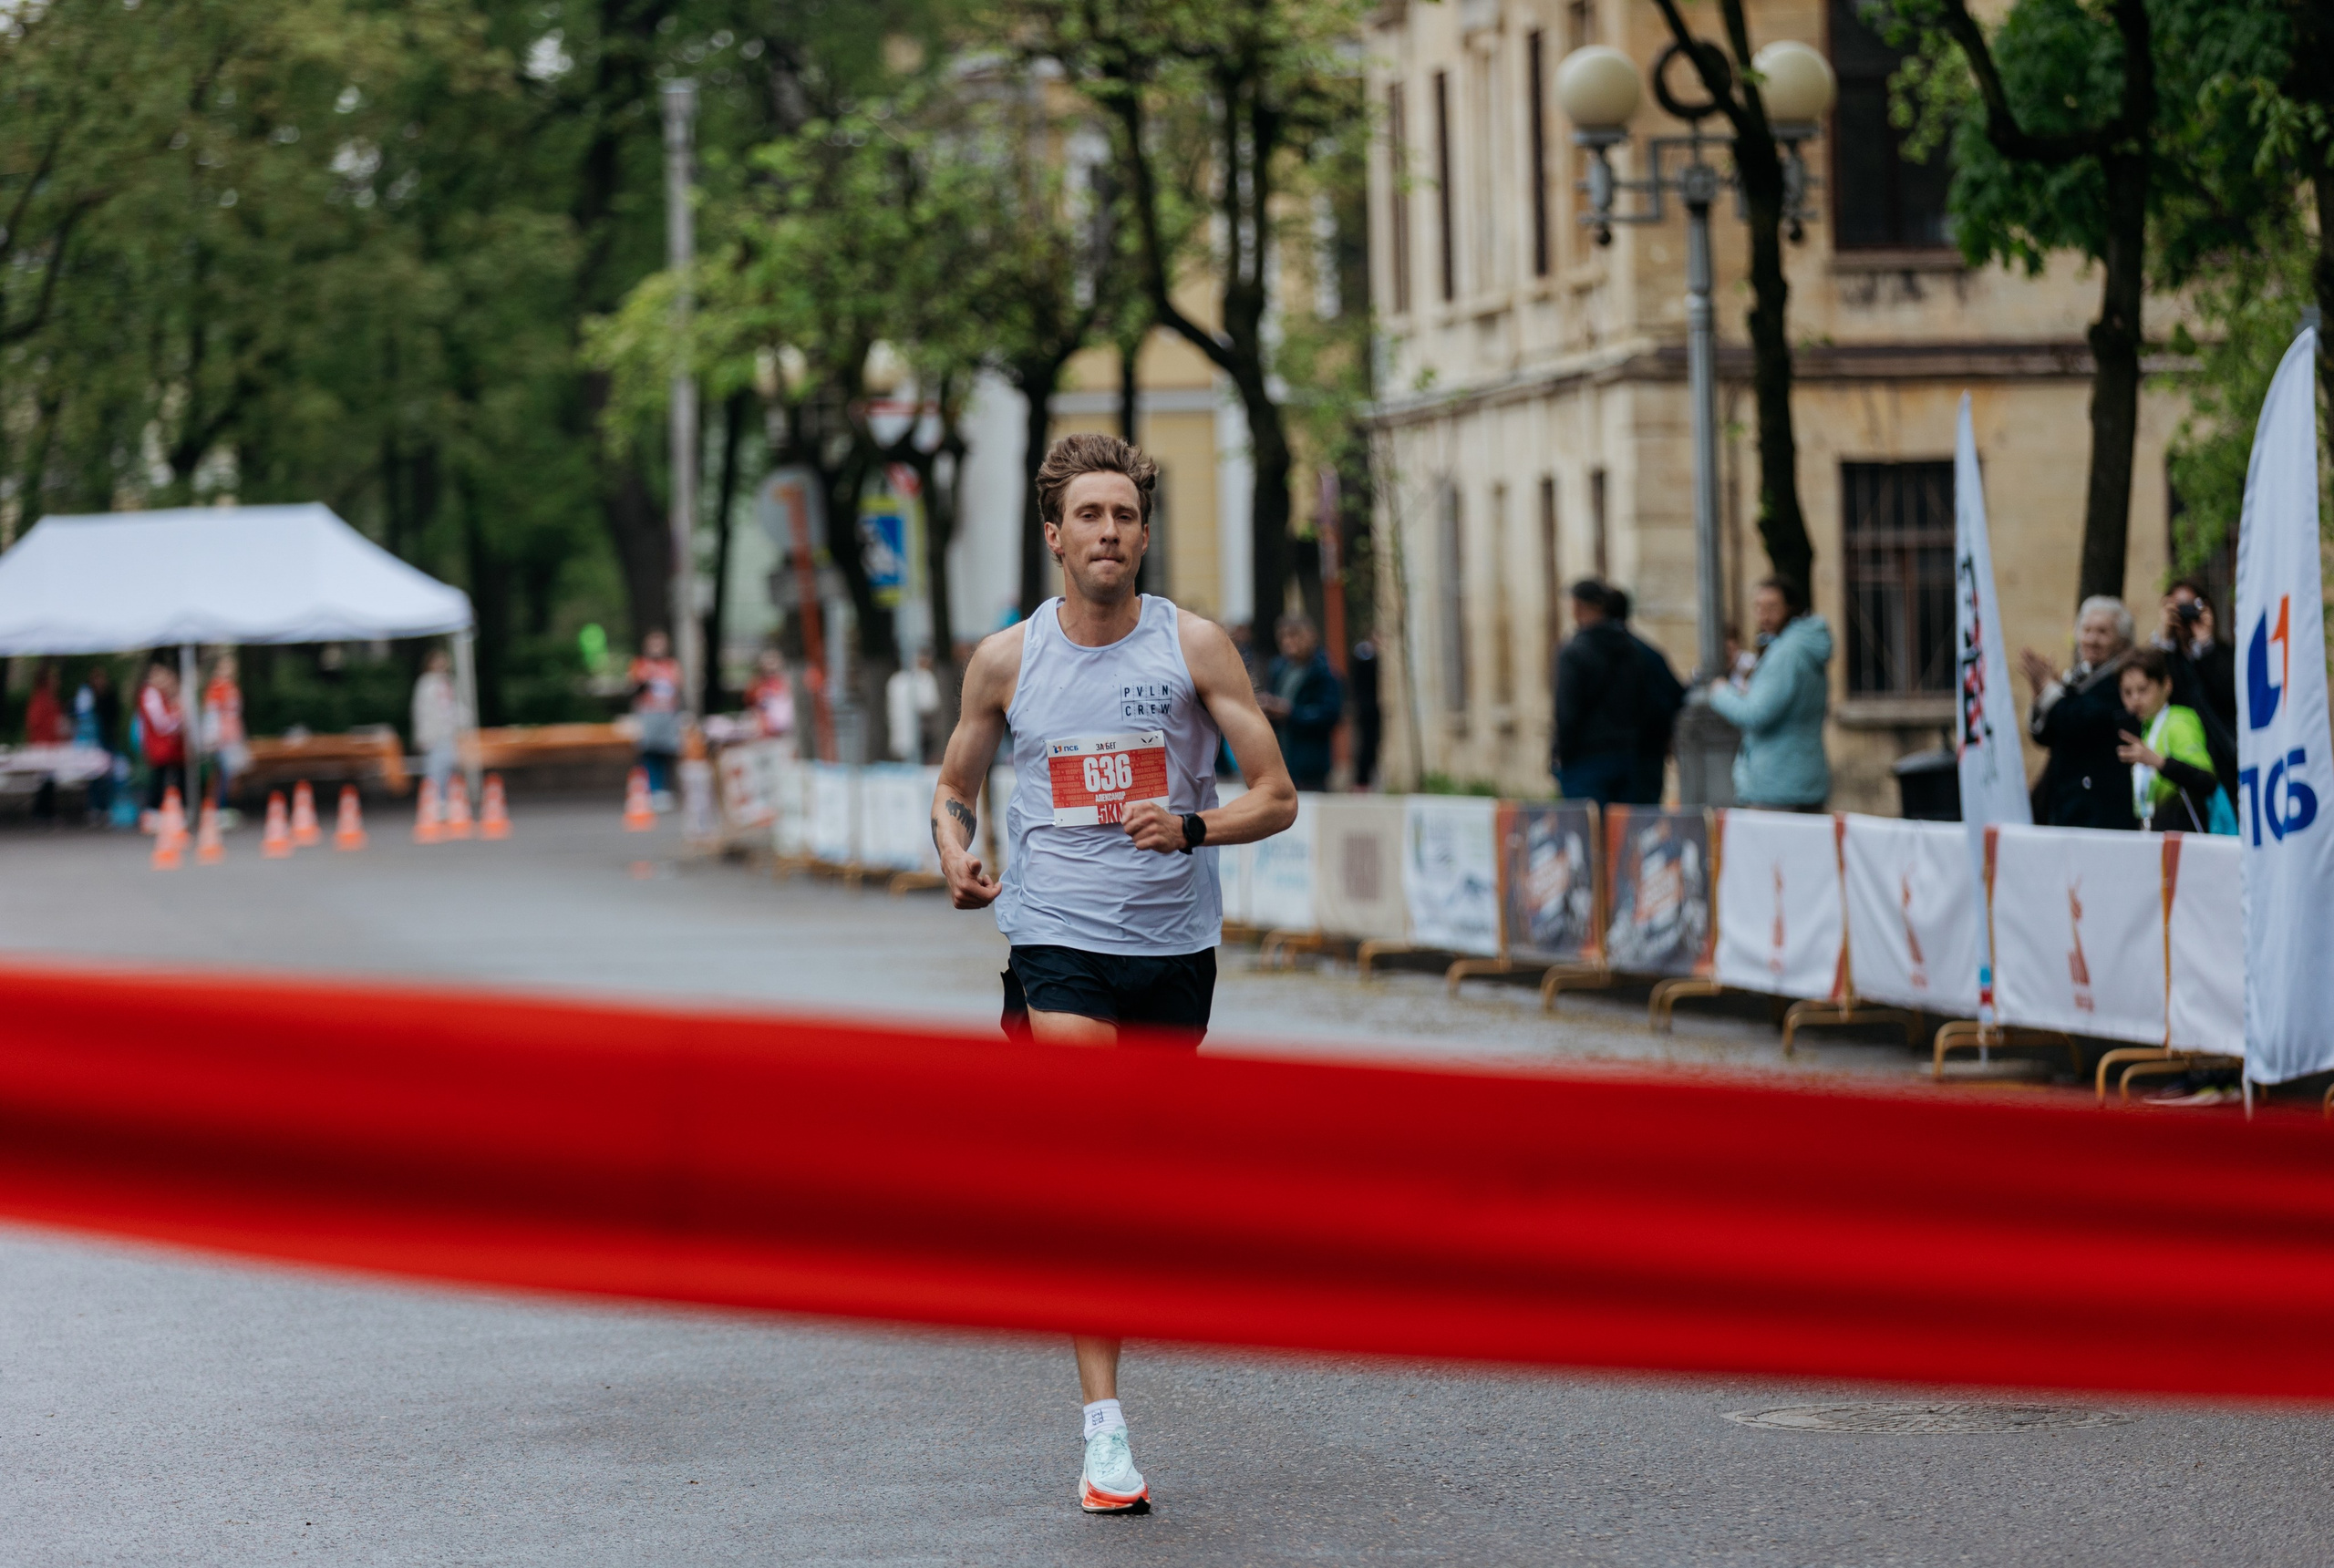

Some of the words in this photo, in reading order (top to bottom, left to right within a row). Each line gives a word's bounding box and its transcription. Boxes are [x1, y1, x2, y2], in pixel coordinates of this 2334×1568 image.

[1124, 685, 1169, 697] PVLN
[1125, 703, 1170, 717] CREW
[1083, 754, 1132, 792] 636
